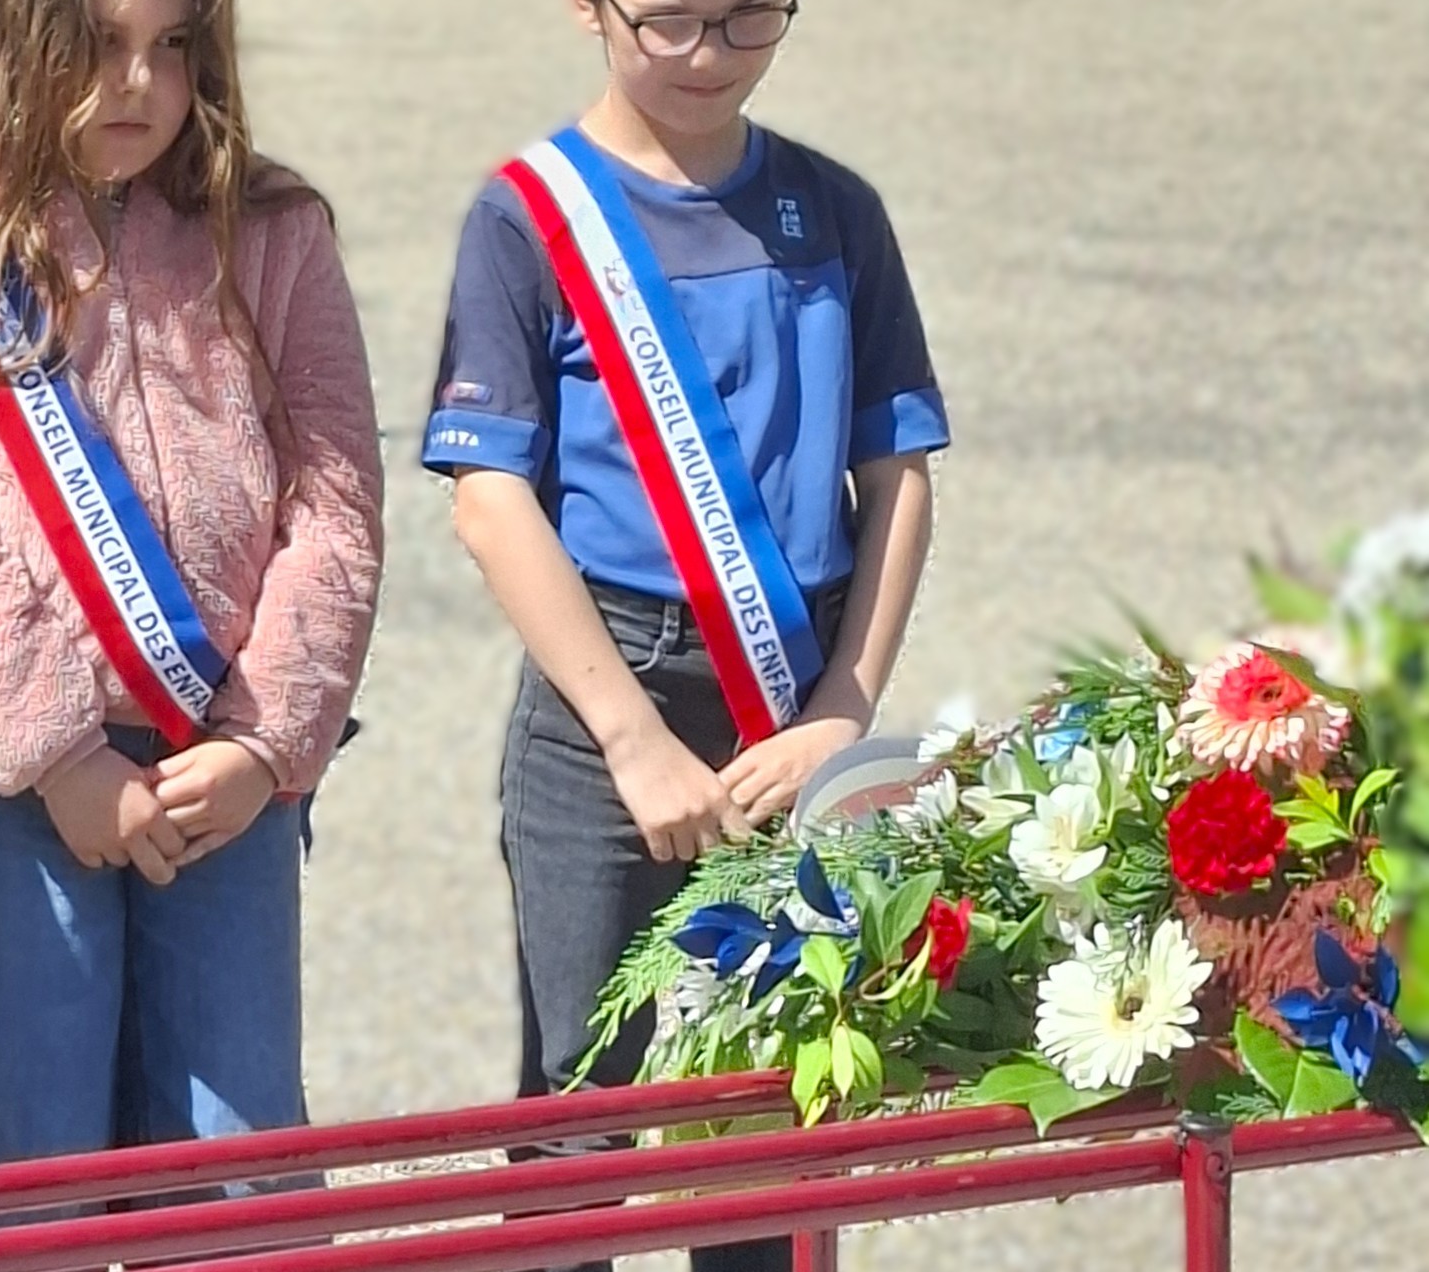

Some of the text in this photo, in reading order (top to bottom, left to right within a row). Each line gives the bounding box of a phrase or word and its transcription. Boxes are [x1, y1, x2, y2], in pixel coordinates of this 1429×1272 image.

[18, 370, 210, 713] ONSEIL MUNICIPAL DES ENFA
[629, 325, 688, 433] CONSEIL
[674, 437, 746, 582] MUNICIPAL
[732, 584, 769, 636] DES
